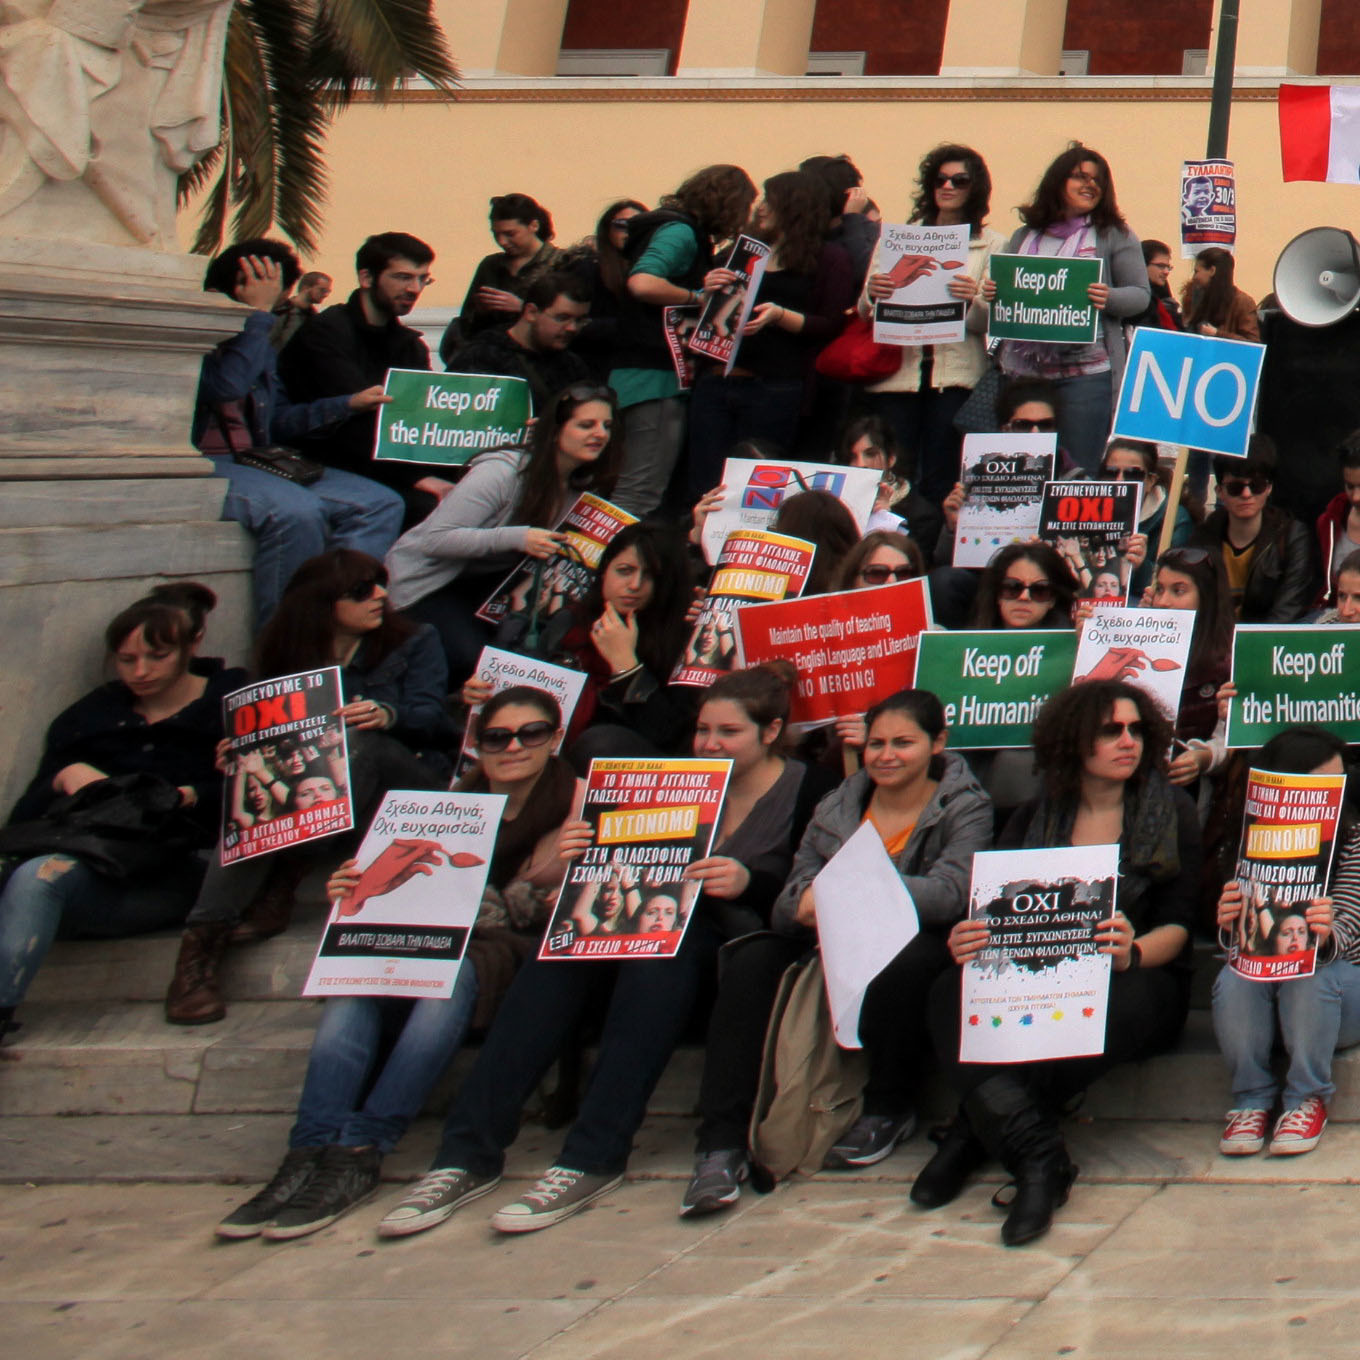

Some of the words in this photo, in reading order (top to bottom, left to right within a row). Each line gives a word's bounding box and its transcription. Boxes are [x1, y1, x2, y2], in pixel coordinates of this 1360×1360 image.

[1015, 267, 1045, 295] Keep
[1048, 268, 1069, 290] off
[994, 300, 1011, 321] the
[1014, 302, 1091, 327] Humanities!
[426, 385, 470, 415] Keep
[474, 388, 501, 411] off
[1129, 349, 1247, 428] NO
[390, 420, 419, 443] the
[986, 461, 1017, 474] ΟΧΙ
[1050, 485, 1113, 496] ΣΥΓΧΩΝΕΥΟΥΜΕ
[1117, 486, 1127, 496] ΤΟ
[1057, 497, 1114, 522] ΟΧΙ
[769, 626, 803, 645] Maintain
[804, 622, 818, 640] the
[819, 619, 844, 641] quality
[846, 615, 855, 634] of
[856, 612, 891, 632] teaching
[1096, 615, 1133, 629] Σχέδιο
[1135, 617, 1178, 630] Αθηνά;
[795, 648, 826, 672] English
[827, 644, 867, 668] Language
[867, 640, 883, 659] and
[884, 634, 920, 656] Literatur
[962, 647, 1010, 685] Keep
[1015, 645, 1045, 677] off
[1272, 645, 1315, 681] Keep
[1320, 643, 1346, 675] off
[820, 669, 875, 694] MERGING!
[233, 691, 308, 736] ΟΧΙ
[1242, 696, 1274, 725] the
[300, 726, 325, 741] ΤΟΥΣ
[604, 774, 616, 787] ΤΟ
[620, 774, 658, 787] ΤΜΗΜΑ
[662, 775, 711, 788] ΑΓΓΛΙΚΗΣ
[587, 789, 630, 803] ΓΛΩΣΣΑΣ
[633, 789, 652, 803] ΚΑΙ
[656, 790, 720, 803] ΦΙΛΟΛΟΓΙΑΣ
[385, 799, 429, 818] Σχέδιο
[431, 802, 485, 819] Αθηνά;
[602, 809, 695, 837] ΑΥΤΟΝΟΜΟ
[1247, 827, 1318, 852] ΑΥΤΟΝΟΜΟ
[583, 847, 608, 864] ΣΤΗ
[613, 846, 693, 864] ΦΙΛΟΣΟΦΙΚΗ
[1012, 892, 1061, 912] ΟΧΙ
